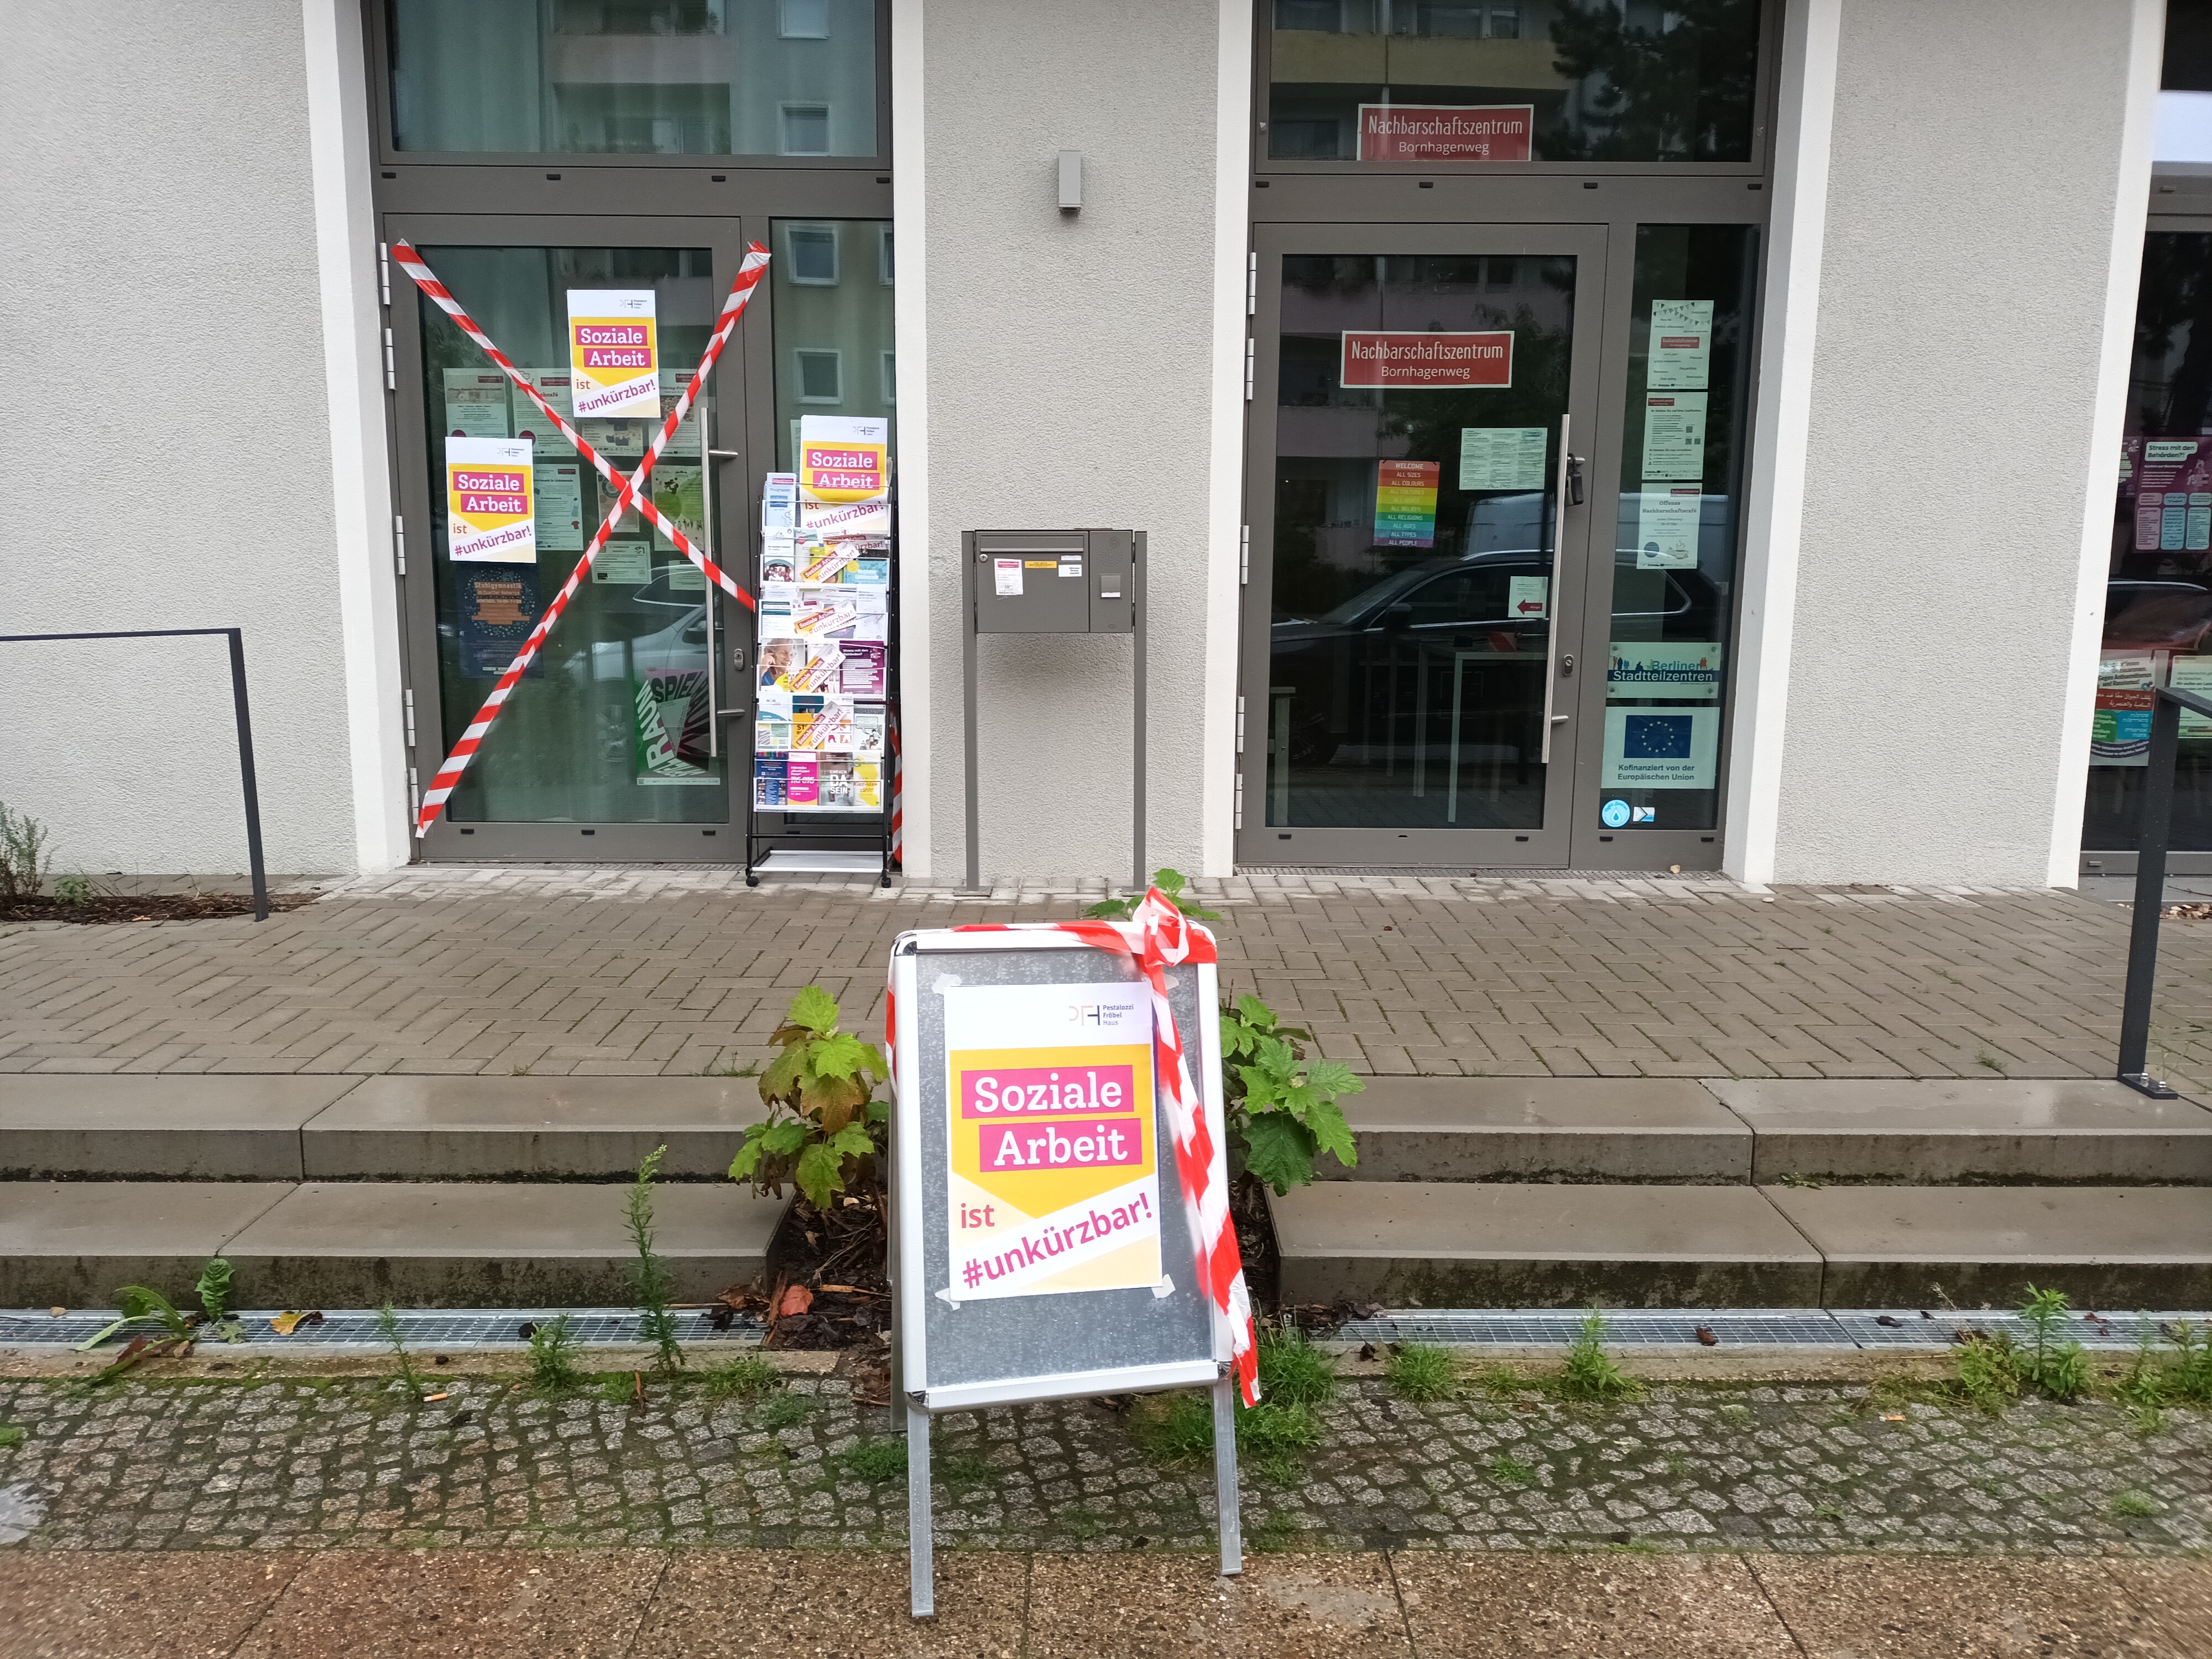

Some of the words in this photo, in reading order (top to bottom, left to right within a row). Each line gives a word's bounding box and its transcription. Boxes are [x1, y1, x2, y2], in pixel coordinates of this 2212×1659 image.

[1368, 115, 1522, 135] Nachbarschaftszentrum
[1399, 142, 1489, 155] Bornhagenweg
[580, 328, 643, 345] Soziale
[589, 351, 646, 366] Arbeit
[1352, 341, 1503, 360] Nachbarschaftszentrum
[1381, 366, 1470, 379] Bornhagenweg
[576, 379, 591, 390] ist
[578, 379, 655, 413] #unkürzbar!
[811, 452, 873, 468] Soziale
[457, 474, 520, 491] Soziale
[818, 473, 874, 489] Arbeit
[466, 496, 522, 512] Arbeit
[804, 499, 820, 510] ist
[806, 500, 884, 529] #unkürzbar!
[452, 524, 467, 534] ist
[454, 526, 532, 557] #unkürzbar!
[805, 564, 822, 577] Soziale
[815, 549, 856, 582] #unkürzbar!
[799, 618, 818, 629] Soziale
[808, 610, 853, 634] #unkürzbar!
[806, 654, 843, 691] #unkürzbar!
[1652, 660, 1701, 671] Berliner
[794, 671, 811, 689] Soziale
[1613, 671, 1713, 682] Stadtteilzentren
[807, 708, 844, 747] #unkürzbar!
[797, 730, 813, 745] Soziale
[830, 774, 848, 787] DA
[974, 1071, 1122, 1113] Soziale
[993, 1125, 1128, 1166] Arbeit
[960, 1203, 995, 1229] ist
[962, 1192, 1152, 1289] #unkürzbar!
